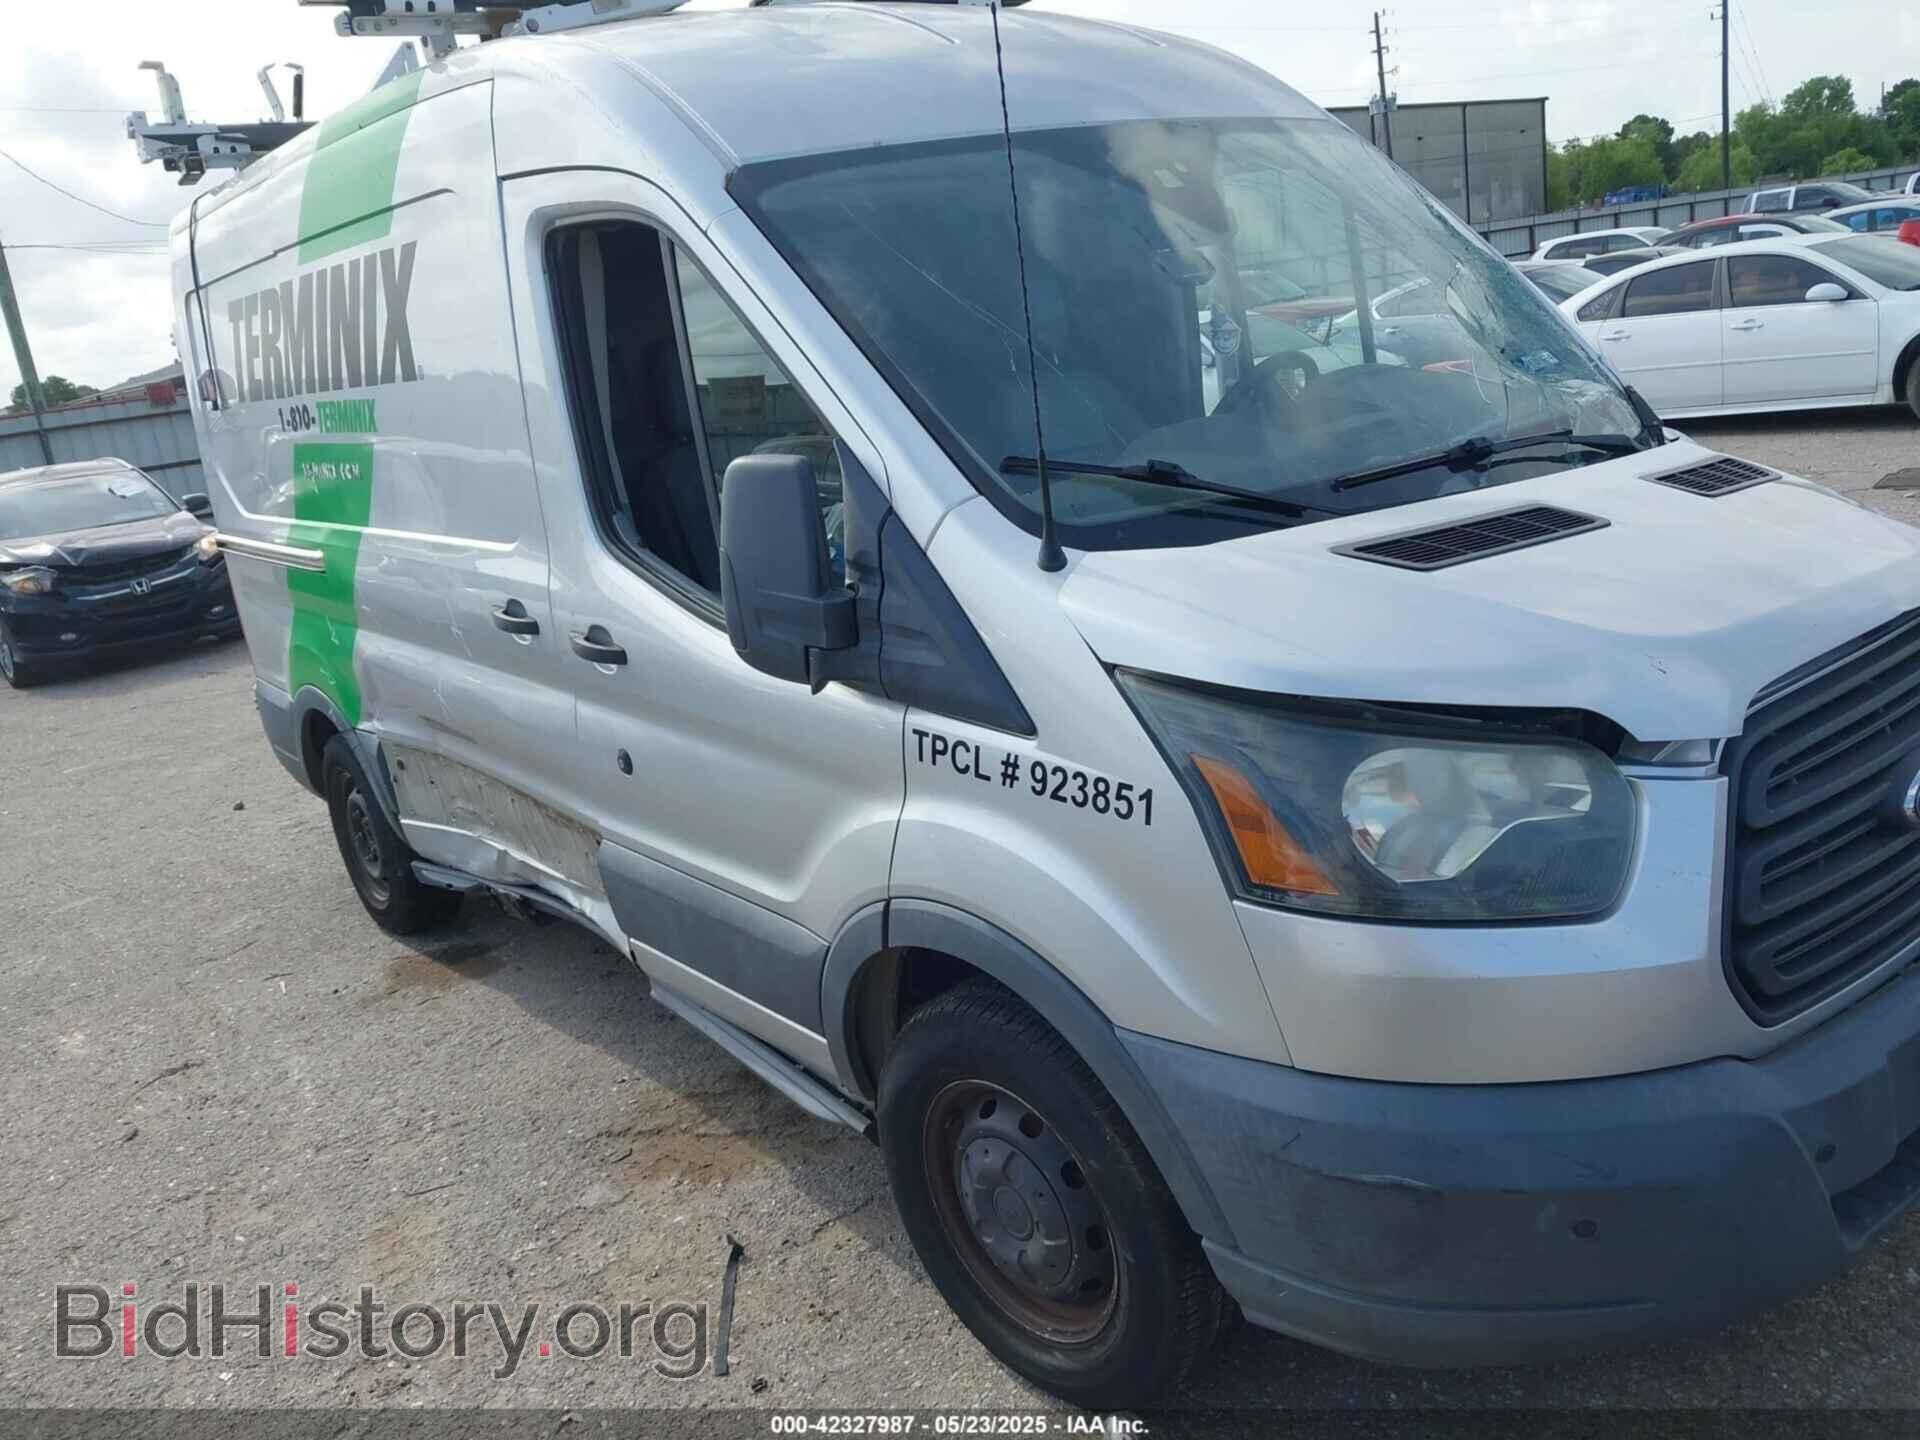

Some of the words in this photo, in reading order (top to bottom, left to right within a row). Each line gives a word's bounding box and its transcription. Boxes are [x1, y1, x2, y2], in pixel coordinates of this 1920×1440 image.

[227, 240, 418, 403] TERMINIX
[912, 728, 991, 782] TPCL
[1001, 752, 1020, 788] #
[1030, 761, 1153, 826] 923851
